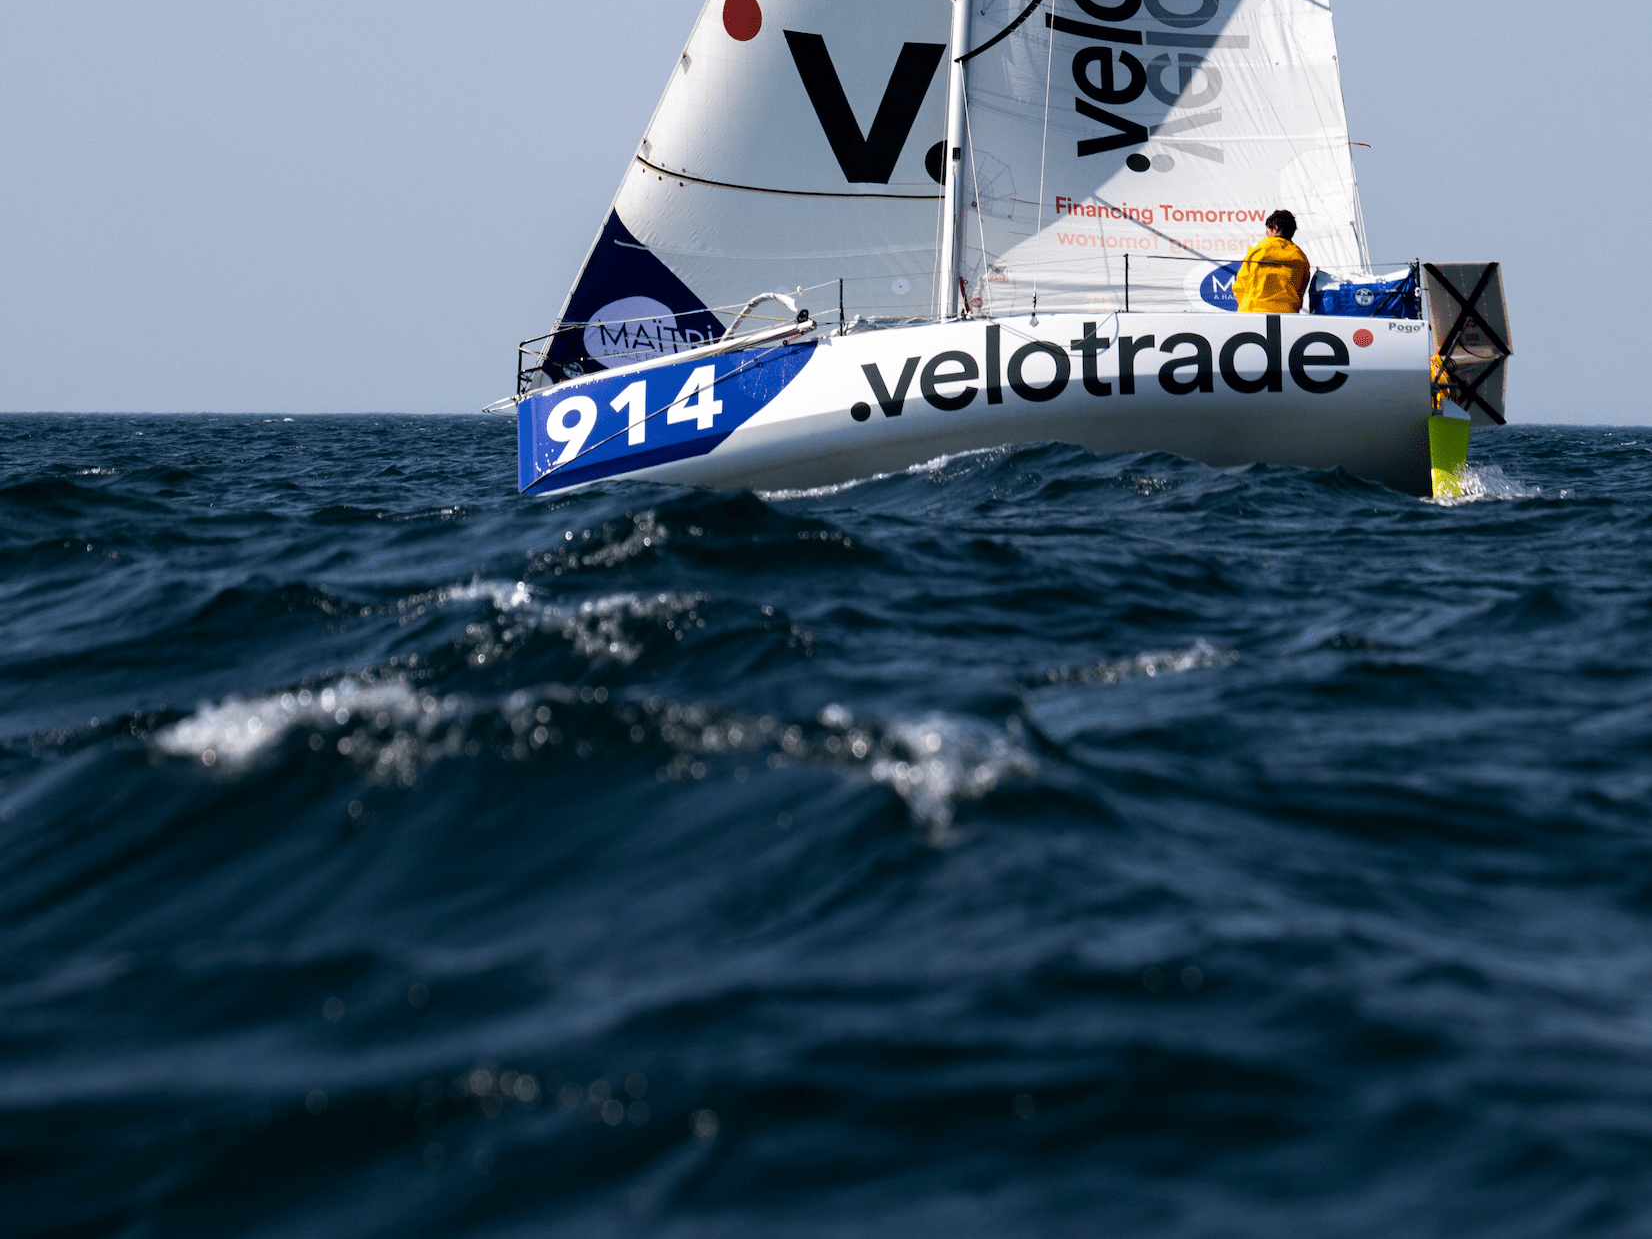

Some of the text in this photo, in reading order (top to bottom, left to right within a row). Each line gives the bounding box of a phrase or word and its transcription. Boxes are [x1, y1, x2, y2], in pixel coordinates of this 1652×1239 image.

[1055, 195, 1266, 225] Financing Tomorrow
[546, 364, 723, 465] 914
[850, 314, 1350, 422] .velotrade
